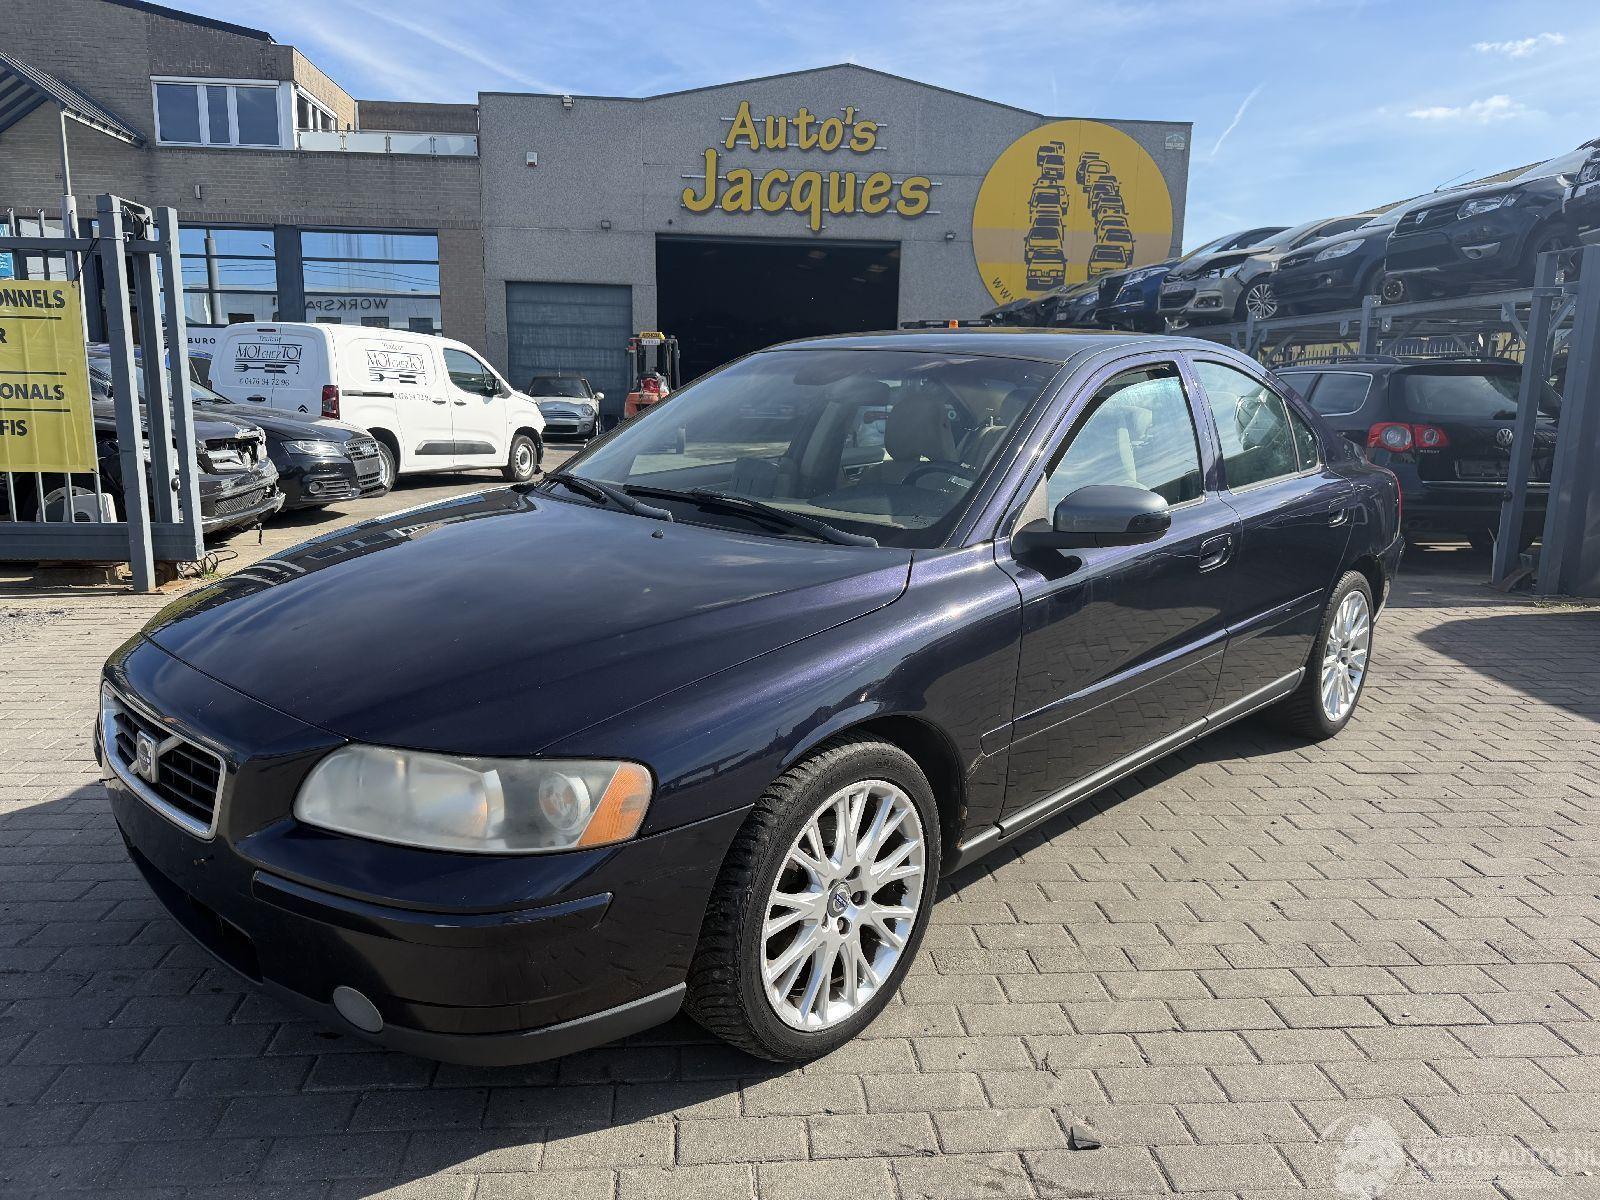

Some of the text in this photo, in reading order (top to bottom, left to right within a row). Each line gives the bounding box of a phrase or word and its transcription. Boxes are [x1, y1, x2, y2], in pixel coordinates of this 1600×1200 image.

[725, 101, 879, 152] Auto's
[682, 148, 932, 232] Jacques
[0, 289, 66, 309] NNELS
[187, 337, 216, 345] BURO
